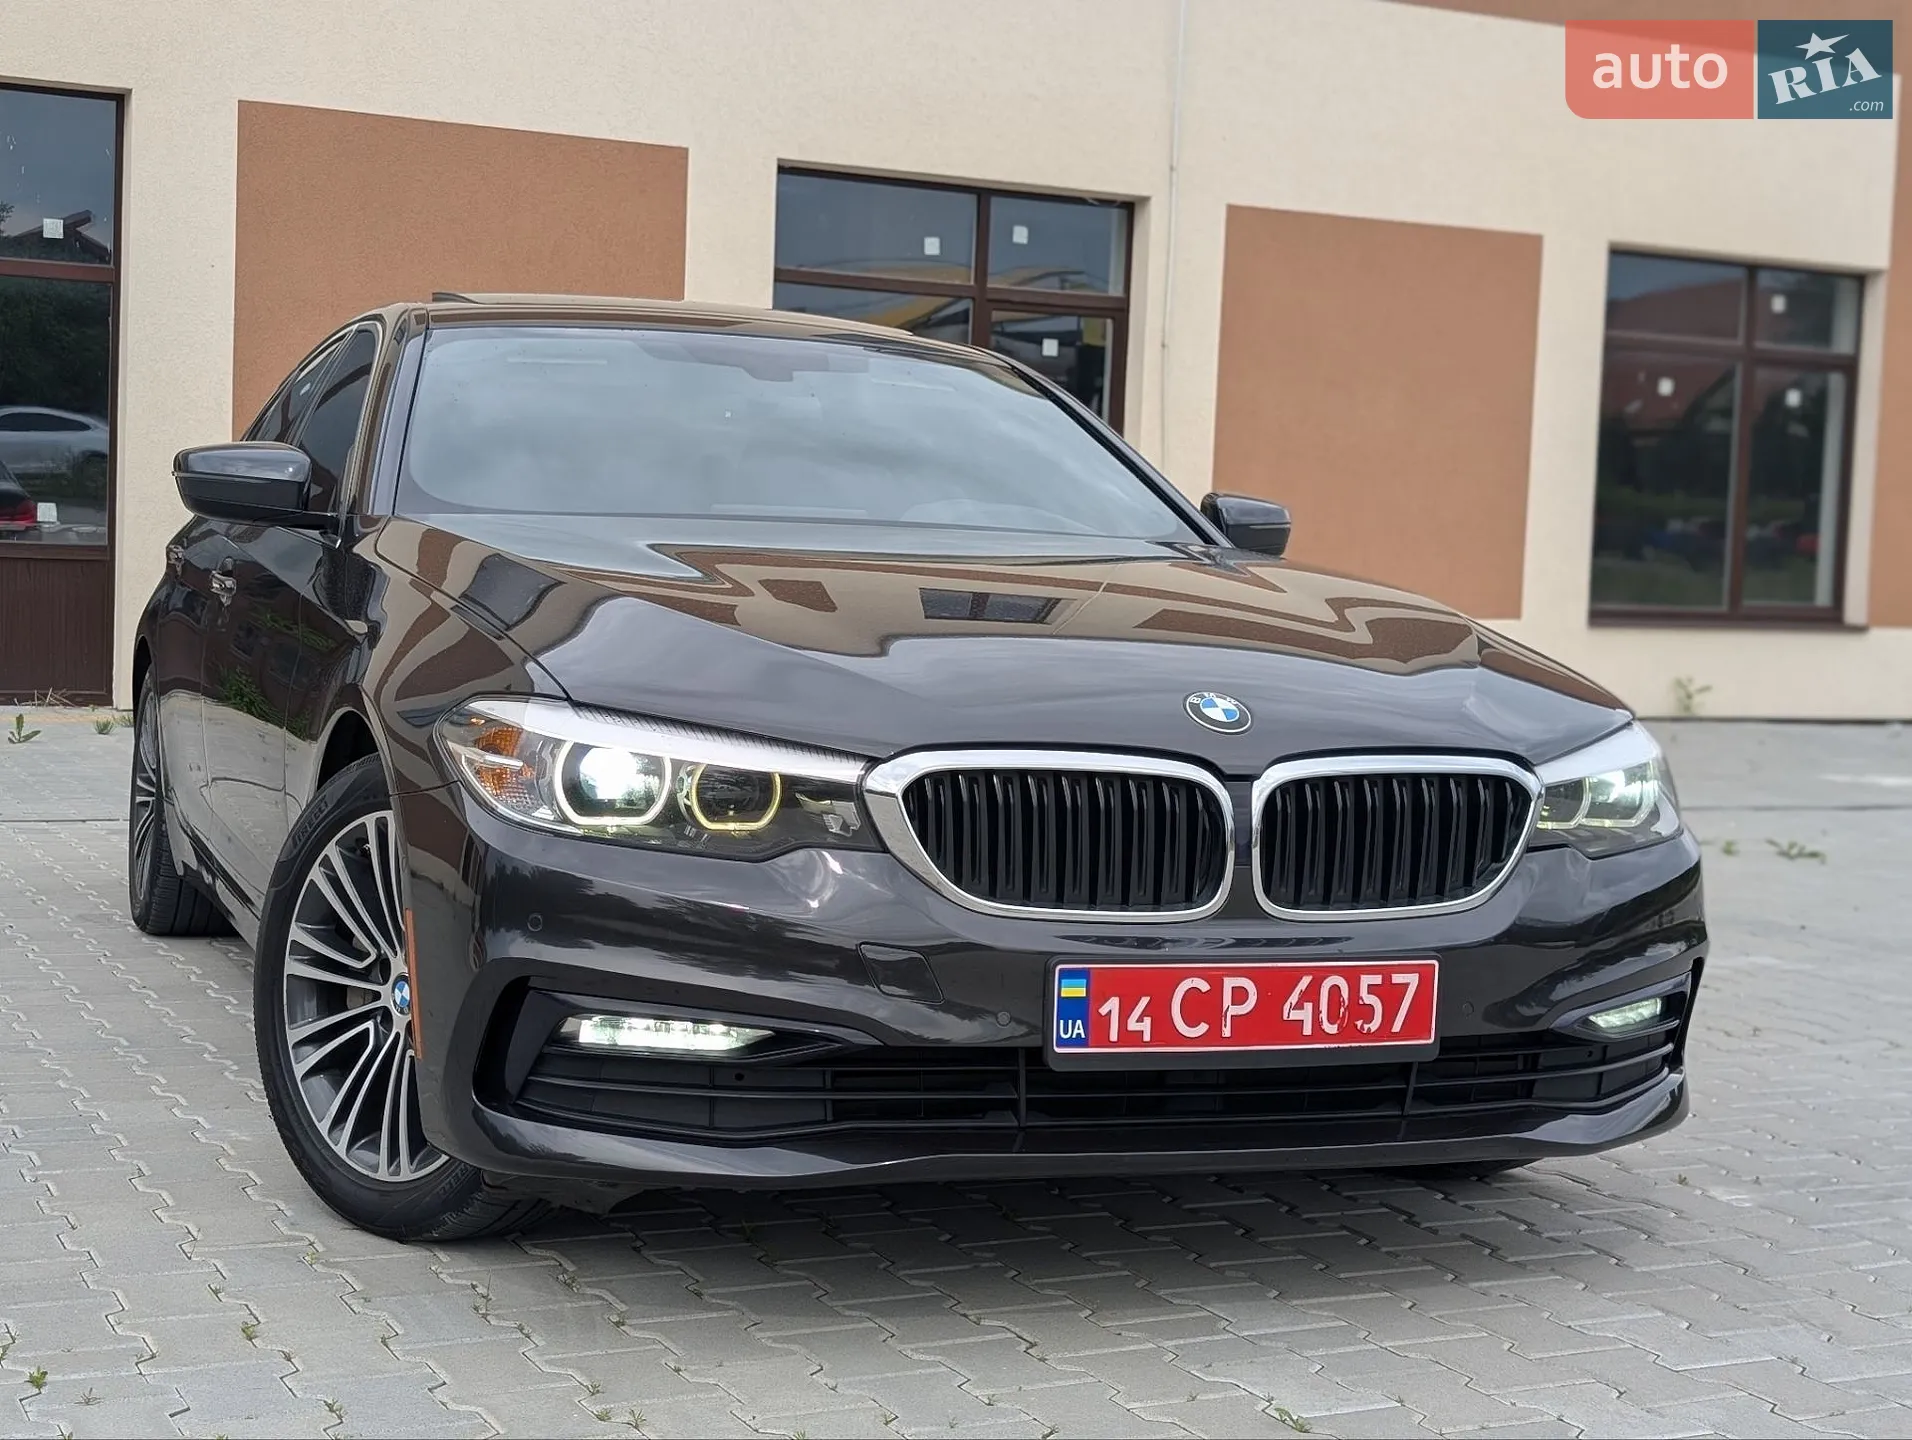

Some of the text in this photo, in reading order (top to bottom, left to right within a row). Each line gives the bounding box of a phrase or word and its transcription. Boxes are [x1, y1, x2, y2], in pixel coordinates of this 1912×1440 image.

[1060, 1019, 1086, 1039] UA
[1098, 996, 1151, 1042] 14
[1282, 973, 1419, 1036] 4057
